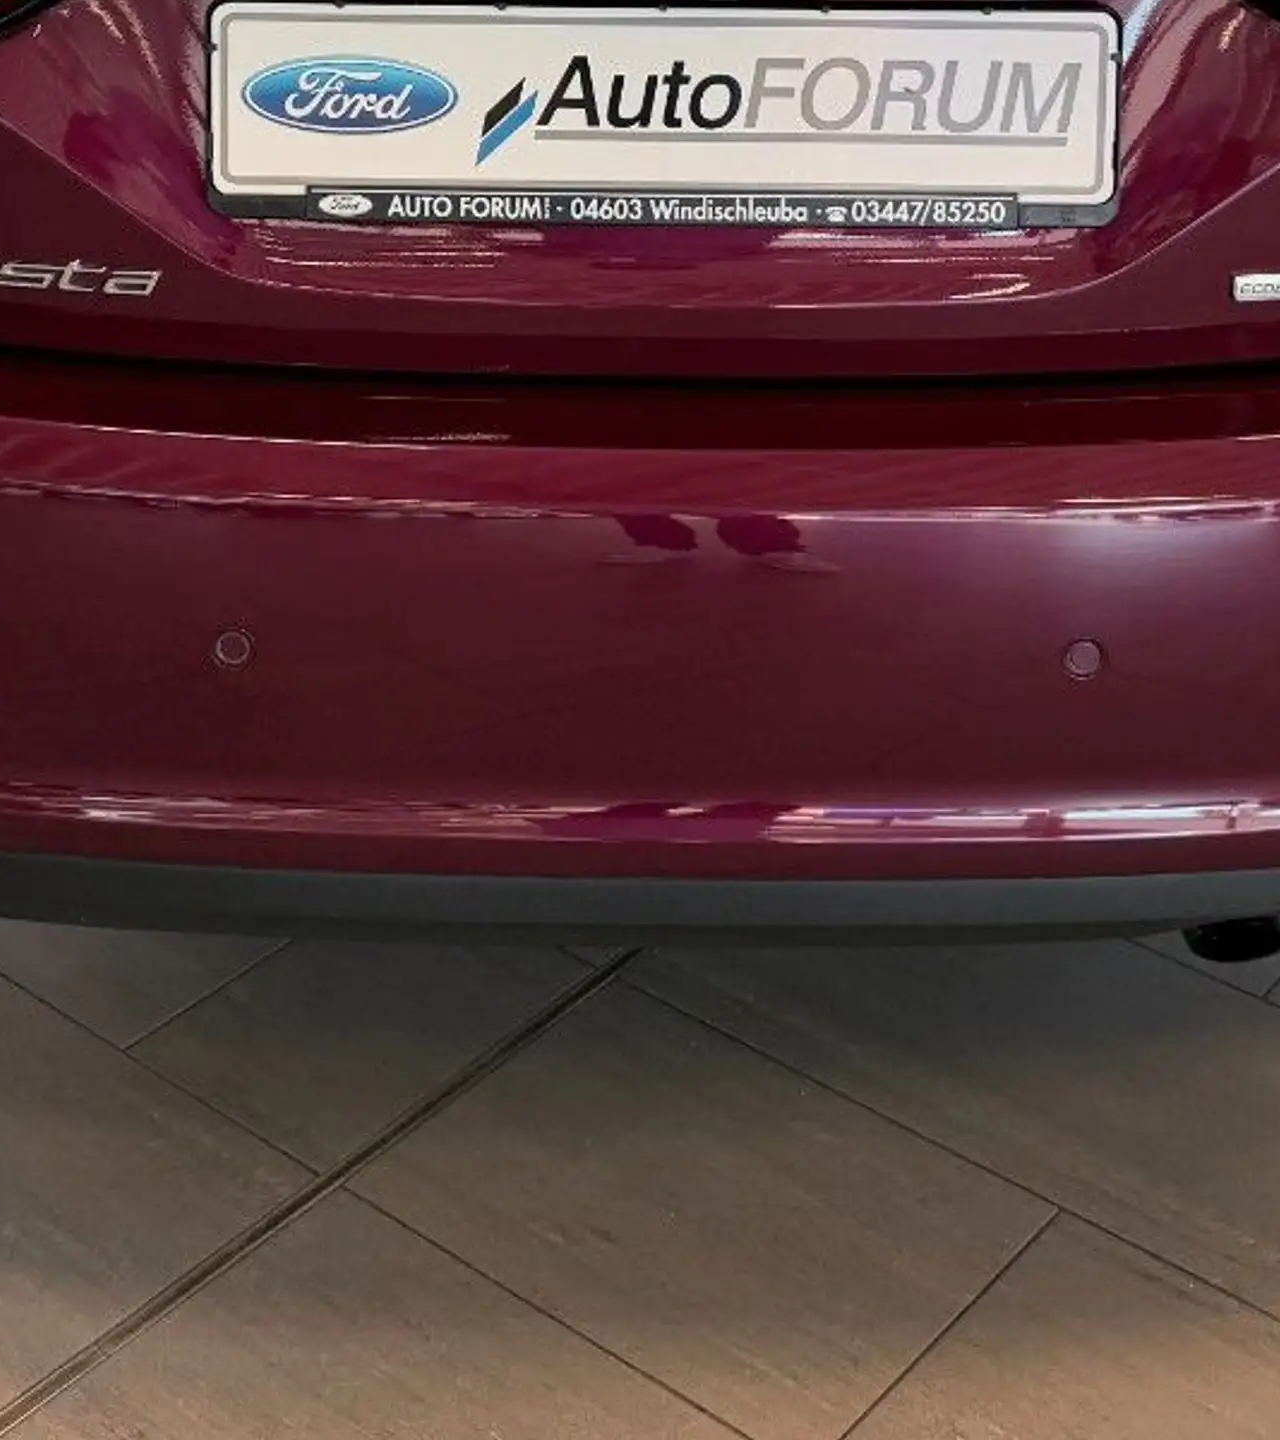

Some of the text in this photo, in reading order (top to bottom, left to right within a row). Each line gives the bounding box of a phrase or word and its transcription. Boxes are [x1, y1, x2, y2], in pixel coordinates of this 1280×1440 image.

[536, 55, 1083, 133] AutoFORUM
[387, 195, 452, 218] AUTO
[459, 196, 542, 219] FORUM
[570, 197, 643, 220] 04603
[649, 195, 809, 222] Windischleuba
[851, 198, 1007, 226] 03447/85250
